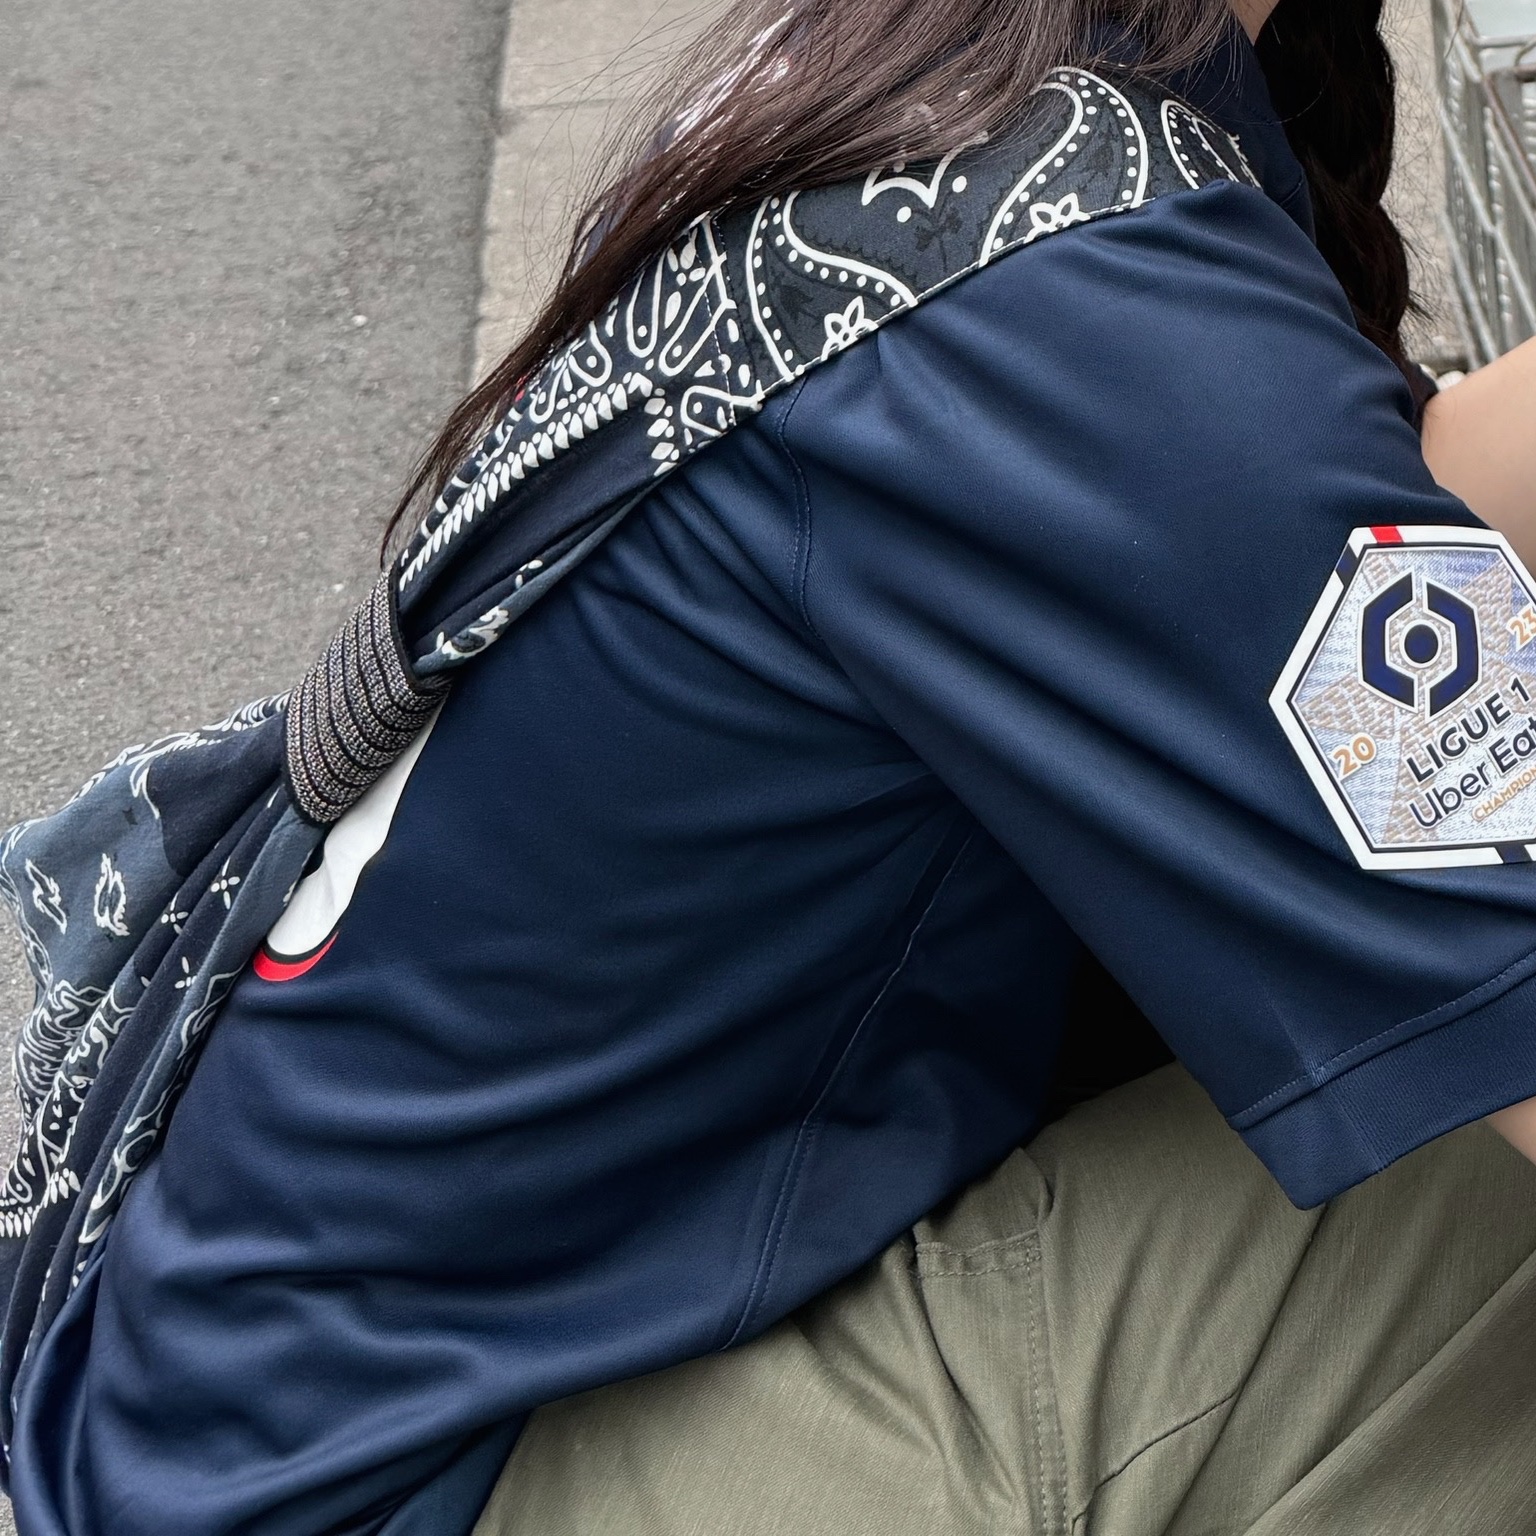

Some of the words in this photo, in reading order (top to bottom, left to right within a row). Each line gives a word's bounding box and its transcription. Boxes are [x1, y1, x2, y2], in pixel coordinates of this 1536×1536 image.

[1333, 736, 1377, 777] 20
[1406, 692, 1512, 783] LIGUE
[1510, 677, 1530, 703] 1
[1409, 761, 1490, 827] Uber
